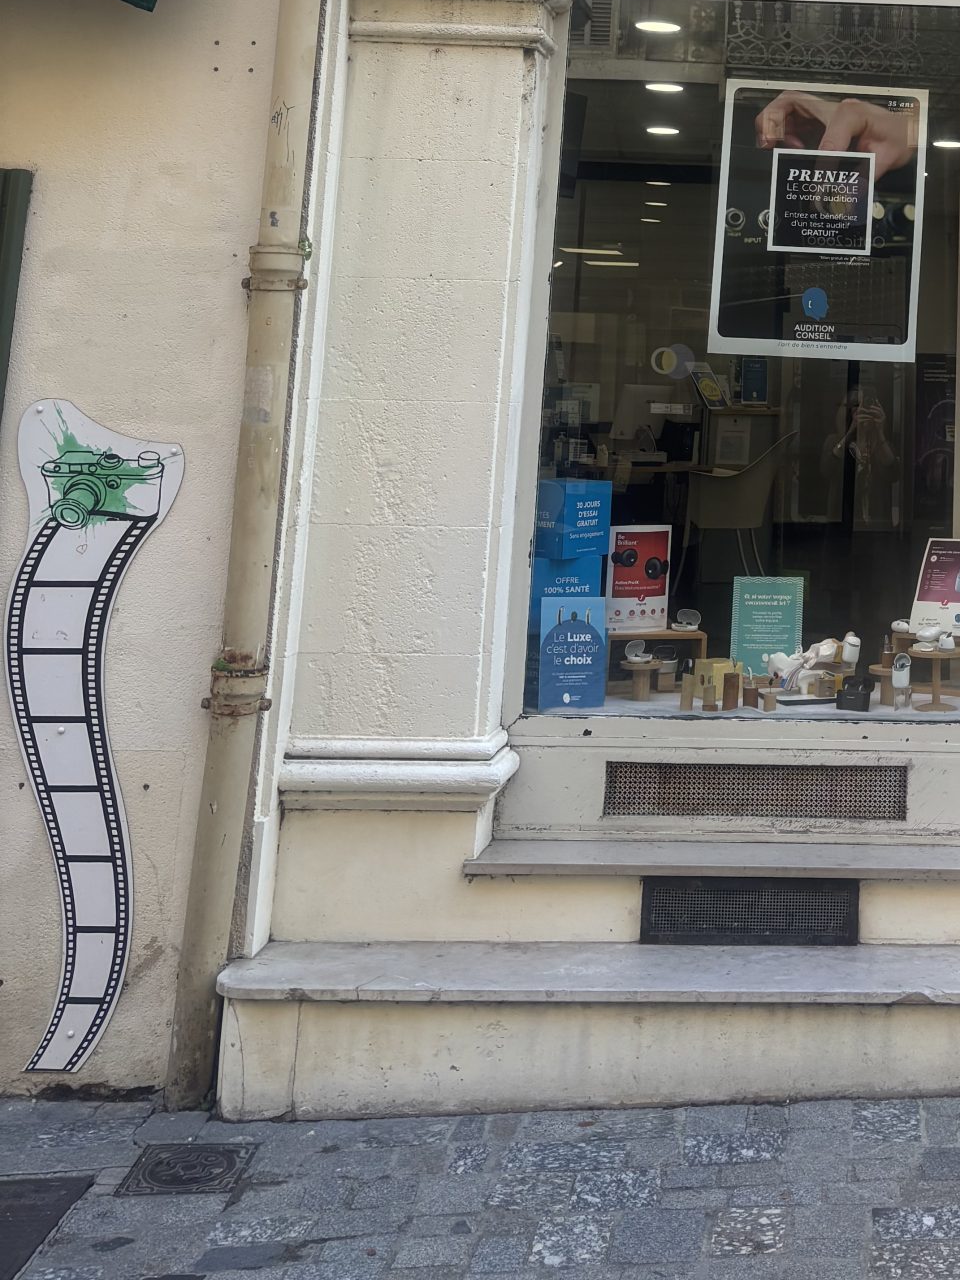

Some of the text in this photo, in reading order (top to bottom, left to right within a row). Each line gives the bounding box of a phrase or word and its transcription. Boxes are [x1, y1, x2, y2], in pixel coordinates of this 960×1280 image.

[787, 168, 860, 184] PRENEZ
[786, 182, 859, 195] LE CONTRÔLE
[823, 194, 858, 203] audition
[784, 211, 809, 219] Entrez
[794, 324, 835, 332] AUDITION
[795, 332, 831, 340] CONSEIL
[584, 500, 601, 508] JOURS
[578, 510, 598, 518] D'ESSAI
[577, 519, 599, 527] GRATUIT
[565, 584, 590, 593] SANTÉ
[554, 632, 593, 643] Le Luxe,
[546, 643, 599, 653] c'est d'avoir
[553, 654, 592, 665] le choix
